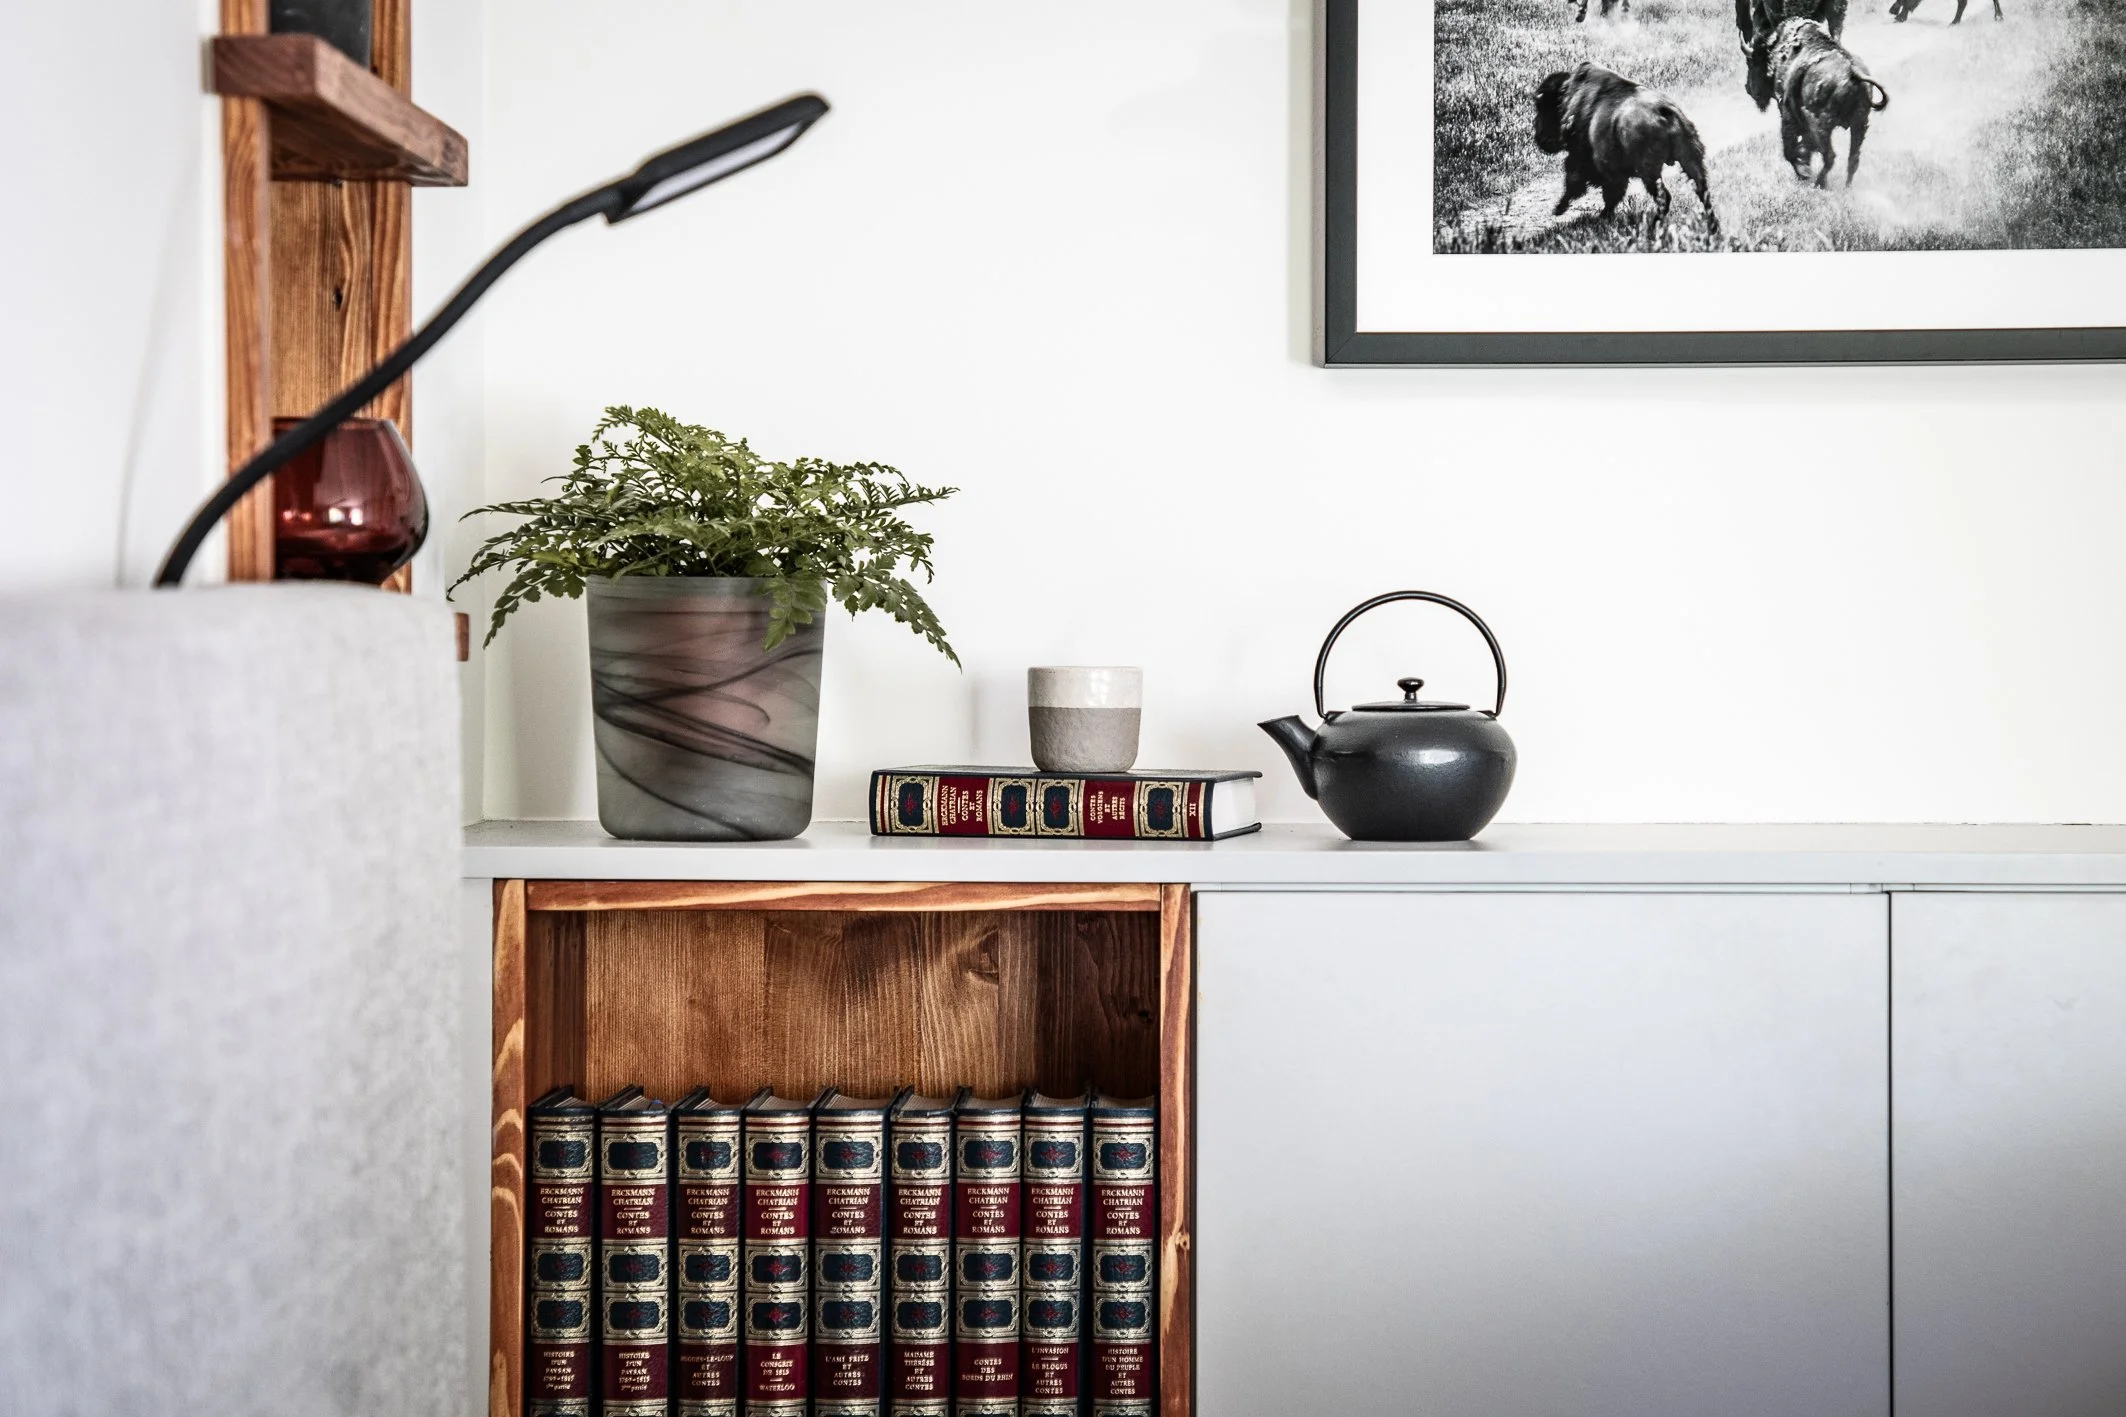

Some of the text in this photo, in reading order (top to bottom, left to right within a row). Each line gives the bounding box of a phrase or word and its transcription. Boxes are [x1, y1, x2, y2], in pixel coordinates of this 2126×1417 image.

[969, 802, 974, 810] ET
[1105, 804, 1110, 813] ET
[540, 1187, 584, 1195] ERCKMANN
[611, 1188, 655, 1197] ERCKMANN
[686, 1188, 730, 1196] ERCKMANN
[756, 1188, 799, 1196] ERCKMANN
[827, 1188, 870, 1196] ERCKMANN
[898, 1188, 942, 1196] ERCKMANN
[968, 1187, 1010, 1196] ERCKMANN
[1031, 1188, 1074, 1196] ERCKMANN
[1101, 1189, 1145, 1197] ERCKMANN
[542, 1196, 583, 1205] CHATRIAN
[613, 1197, 653, 1206] CHATRIAN
[688, 1197, 728, 1206] CHATRIAN
[757, 1198, 797, 1206] CHATRIAN
[828, 1197, 869, 1205] CHATRIAN
[900, 1197, 940, 1206] CHATRIAN
[969, 1196, 1008, 1204] CHATRIAN
[1032, 1196, 1073, 1205] CHATRIAN
[1103, 1198, 1143, 1206] CHATRIAN
[545, 1210, 578, 1218] CONTES
[616, 1211, 650, 1219] CONTES
[691, 1211, 724, 1219] CONTES
[761, 1211, 794, 1220] CONTES
[832, 1211, 865, 1219] CONTES
[972, 1210, 1005, 1218] CONTES
[1036, 1210, 1068, 1218] CONTES
[1106, 1212, 1139, 1220] CONTES
[544, 1226, 578, 1234] ROMANS
[616, 1227, 651, 1235] ROMANS
[760, 1227, 795, 1235] ROMANS
[903, 1226, 937, 1234] ROMANS
[972, 1225, 1006, 1234] ROMANS
[1036, 1225, 1070, 1234] ROMANS
[1106, 1227, 1141, 1235] ROMANS
